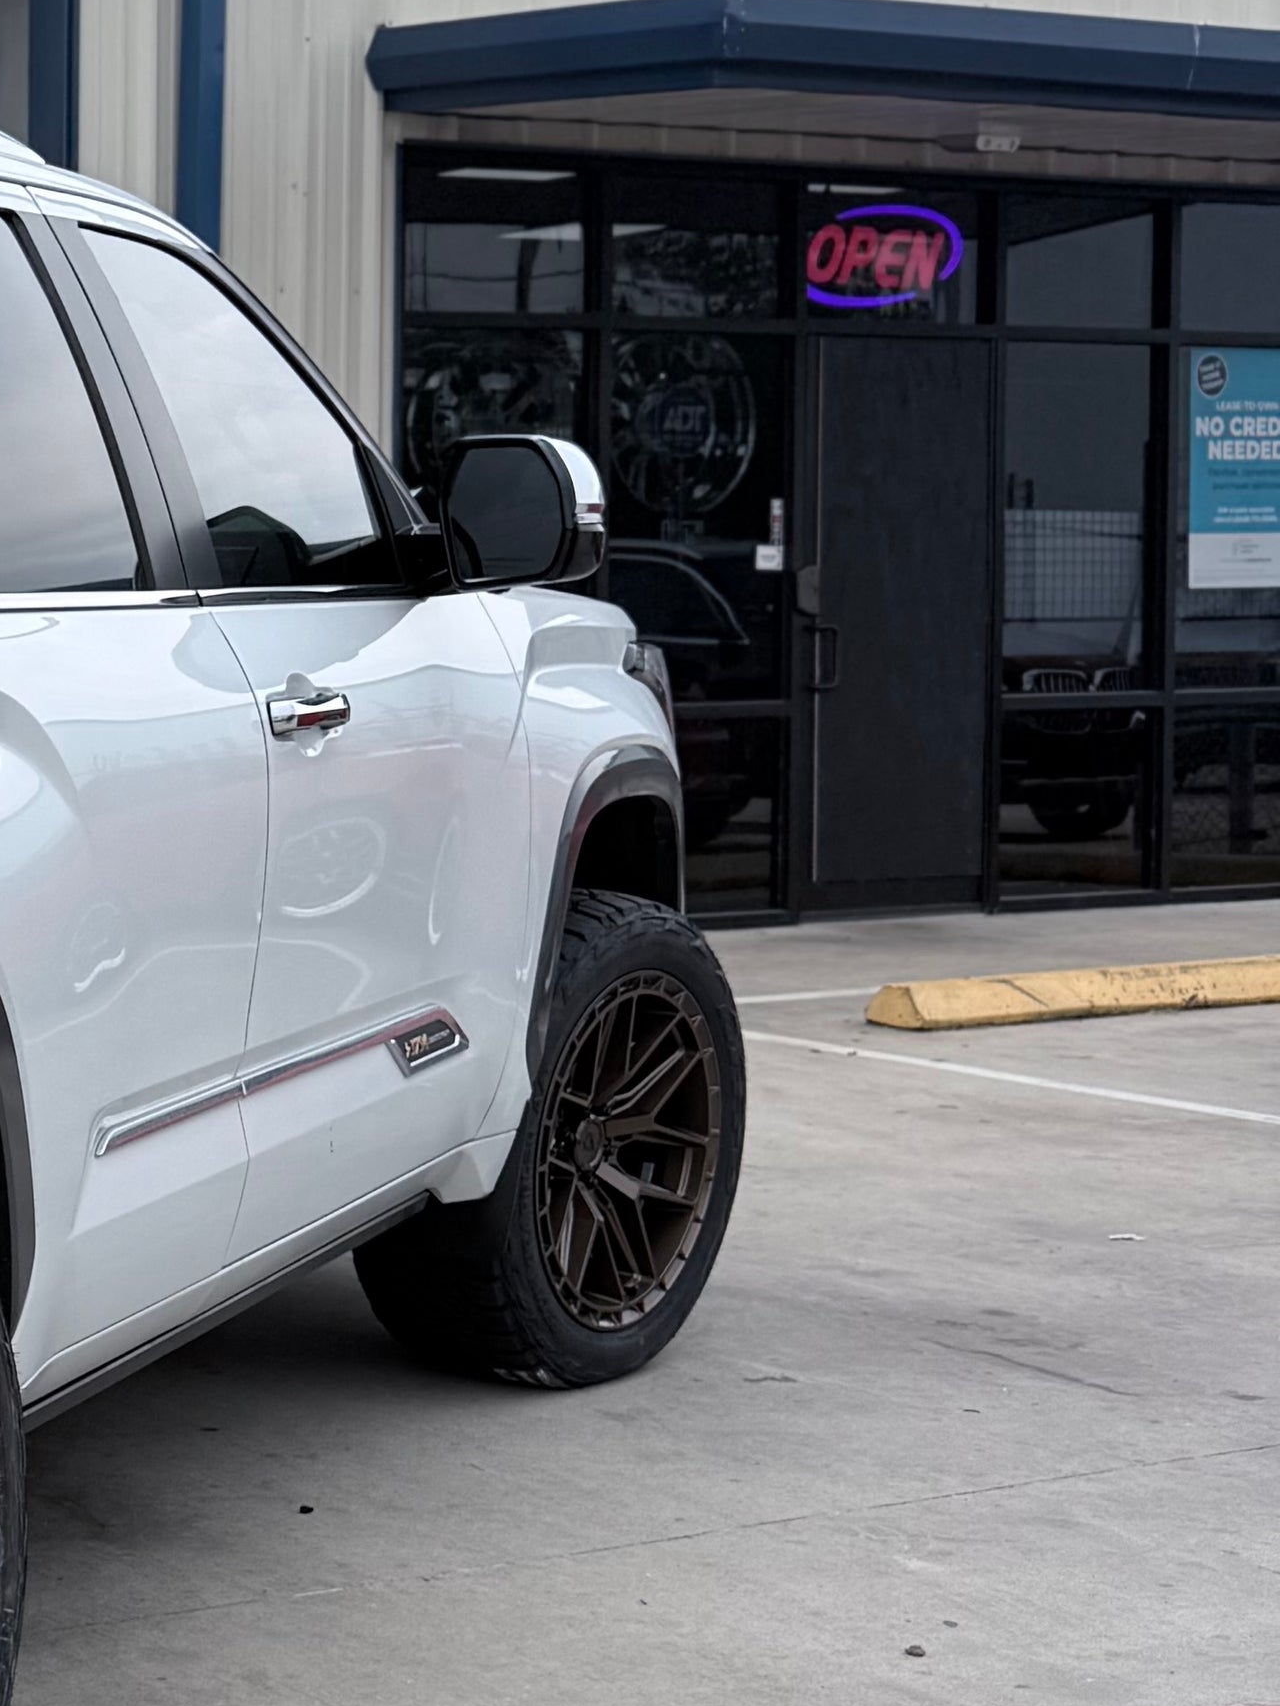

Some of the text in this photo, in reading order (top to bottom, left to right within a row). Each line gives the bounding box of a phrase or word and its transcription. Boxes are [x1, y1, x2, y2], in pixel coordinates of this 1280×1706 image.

[806, 224, 945, 290] OPEN
[663, 405, 706, 431] ADT
[1195, 415, 1225, 437] NO
